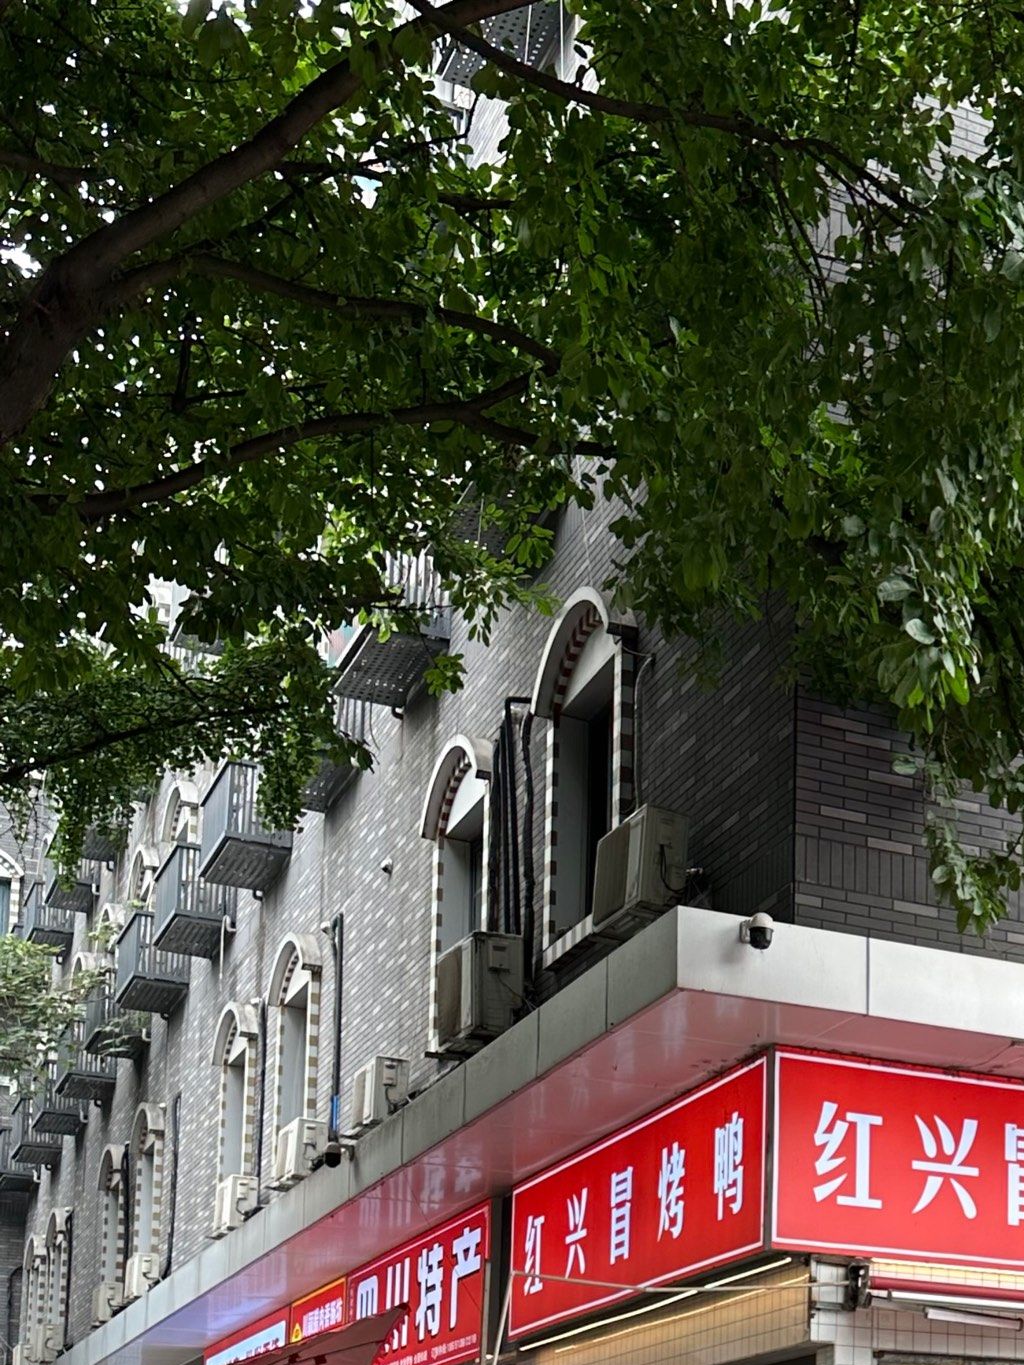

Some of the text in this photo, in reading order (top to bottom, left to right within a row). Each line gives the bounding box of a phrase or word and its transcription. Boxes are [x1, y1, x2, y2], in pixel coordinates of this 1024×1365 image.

[523, 1111, 744, 1296] 红兴冒烤鸭
[356, 1226, 481, 1353] 四川特产
